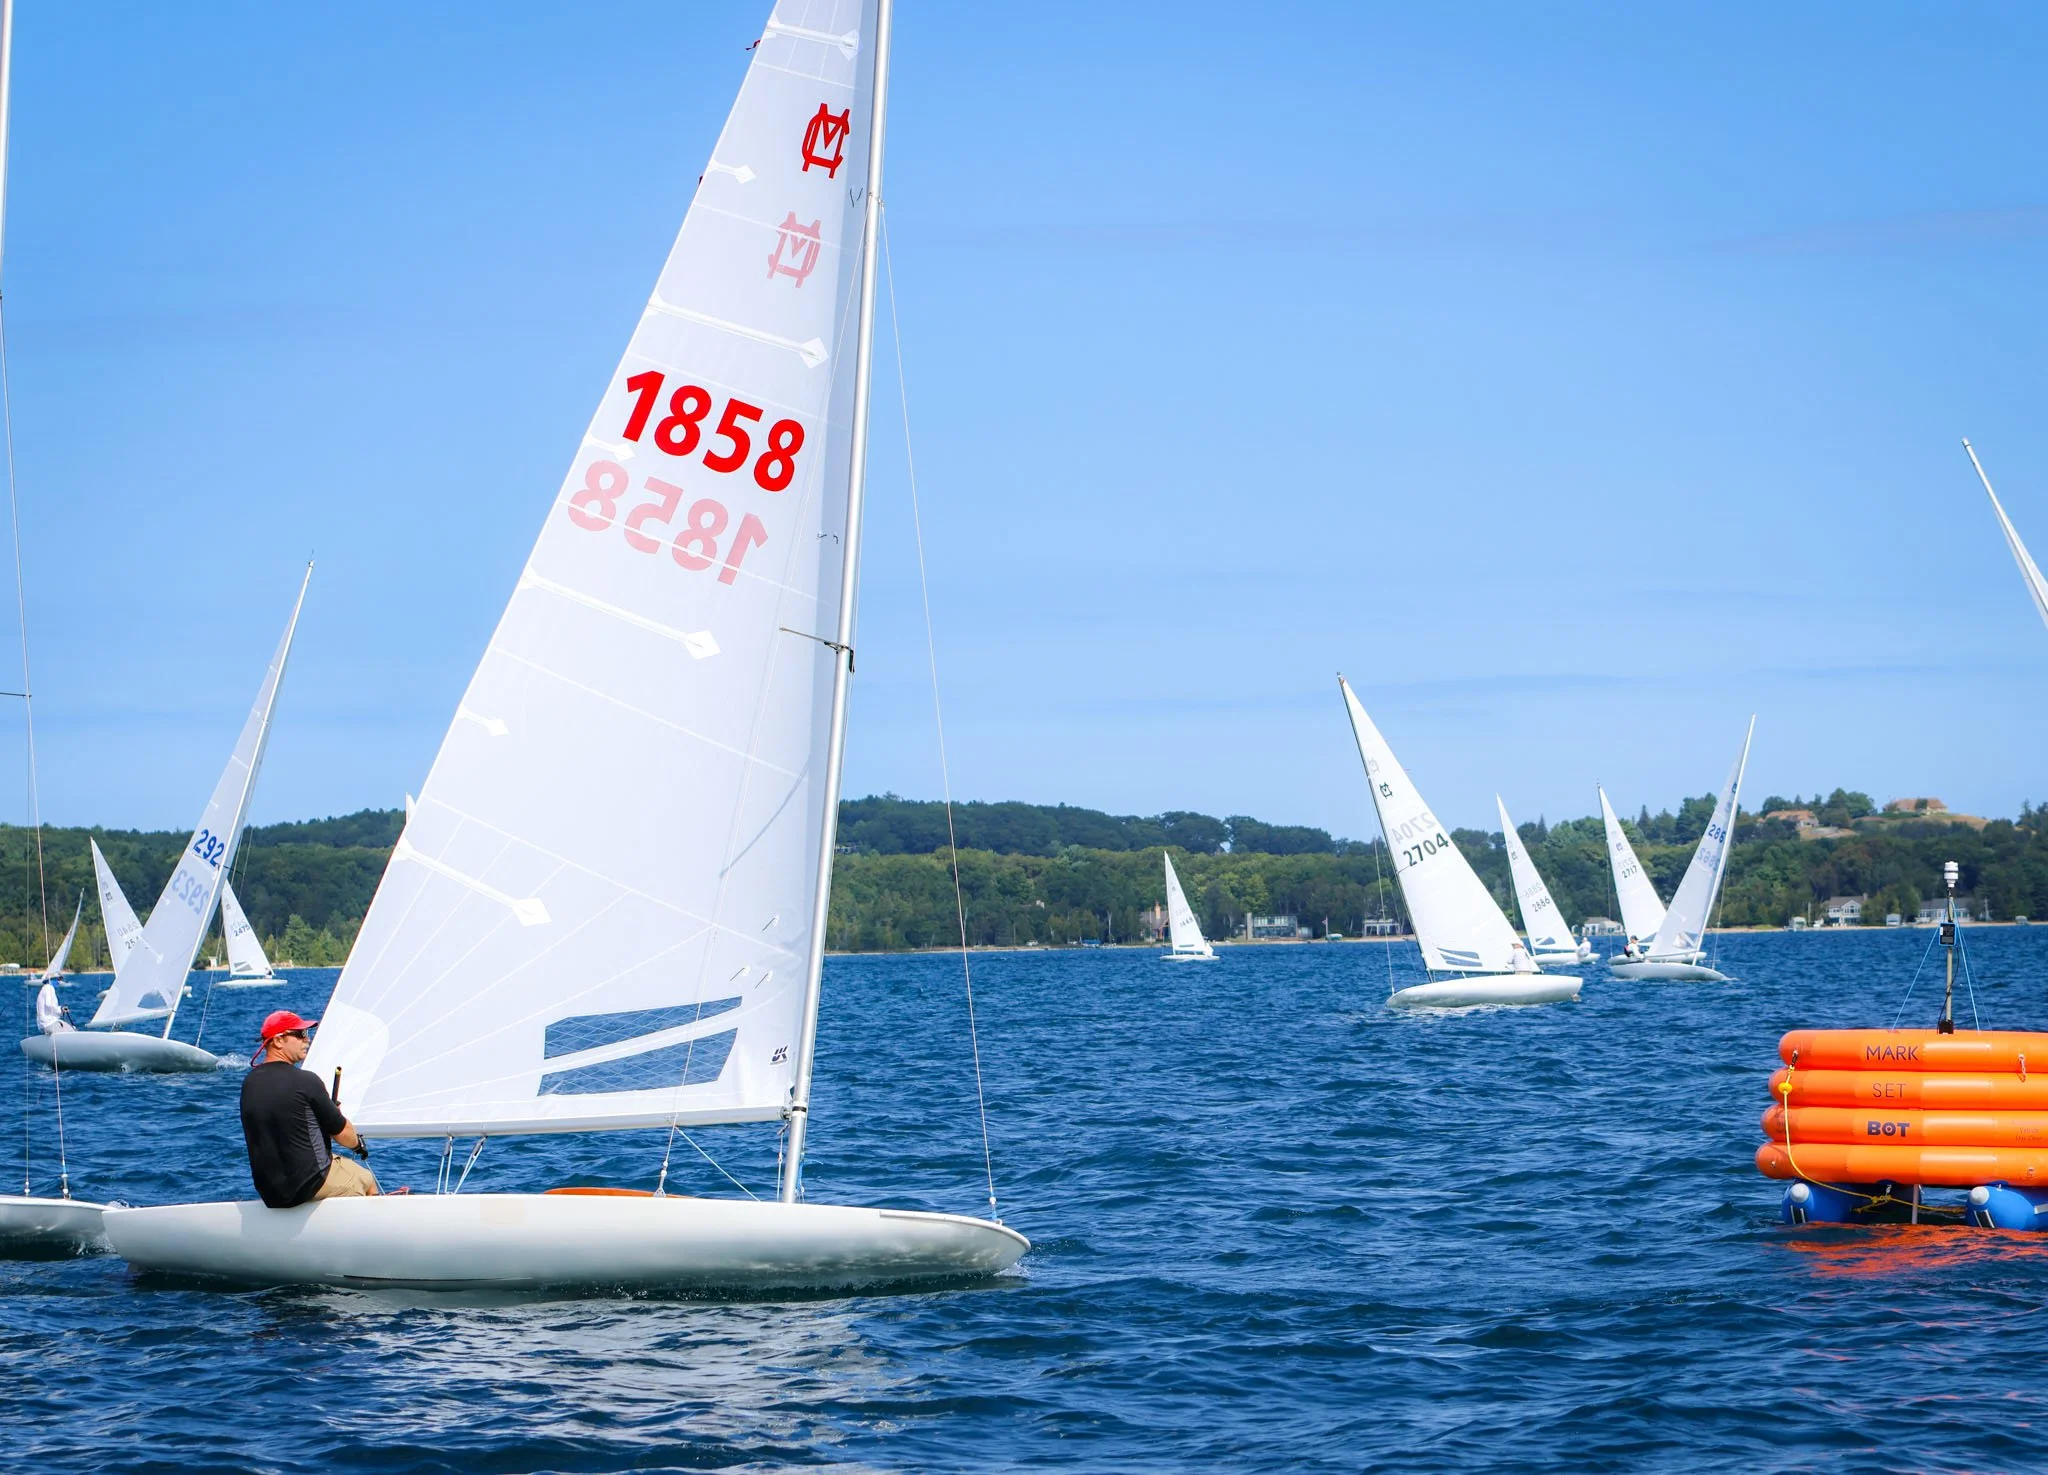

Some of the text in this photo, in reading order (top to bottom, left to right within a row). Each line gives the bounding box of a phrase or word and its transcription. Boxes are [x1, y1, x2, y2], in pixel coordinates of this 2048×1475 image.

[622, 370, 805, 492] 1858
[1403, 833, 1449, 867] 2704
[1866, 1046, 1918, 1060] MARK
[1873, 1083, 1906, 1098] SET
[1867, 1121, 1910, 1137] BOT
